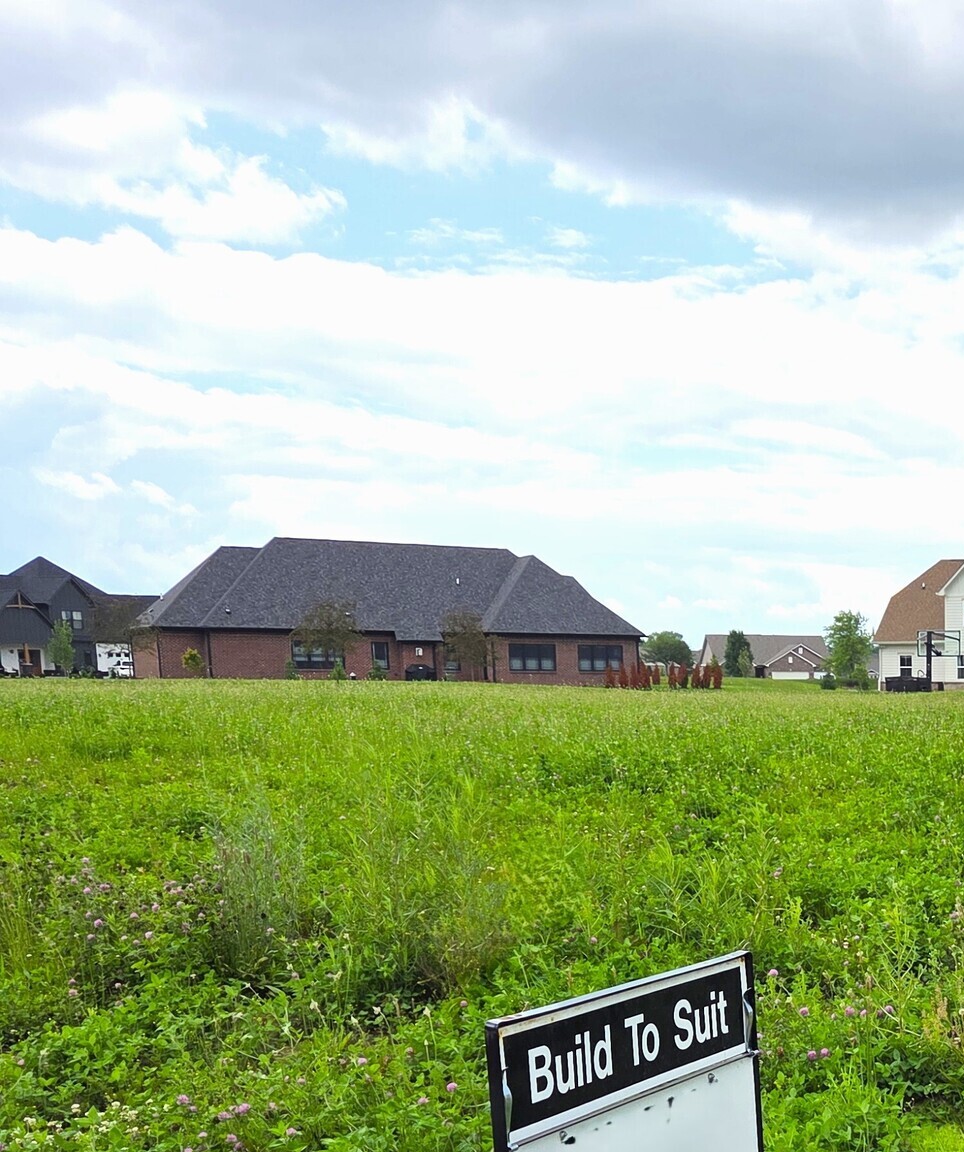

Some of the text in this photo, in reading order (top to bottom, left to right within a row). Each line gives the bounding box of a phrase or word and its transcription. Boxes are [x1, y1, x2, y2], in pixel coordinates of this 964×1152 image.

[527, 990, 729, 1104] Build To Suit
